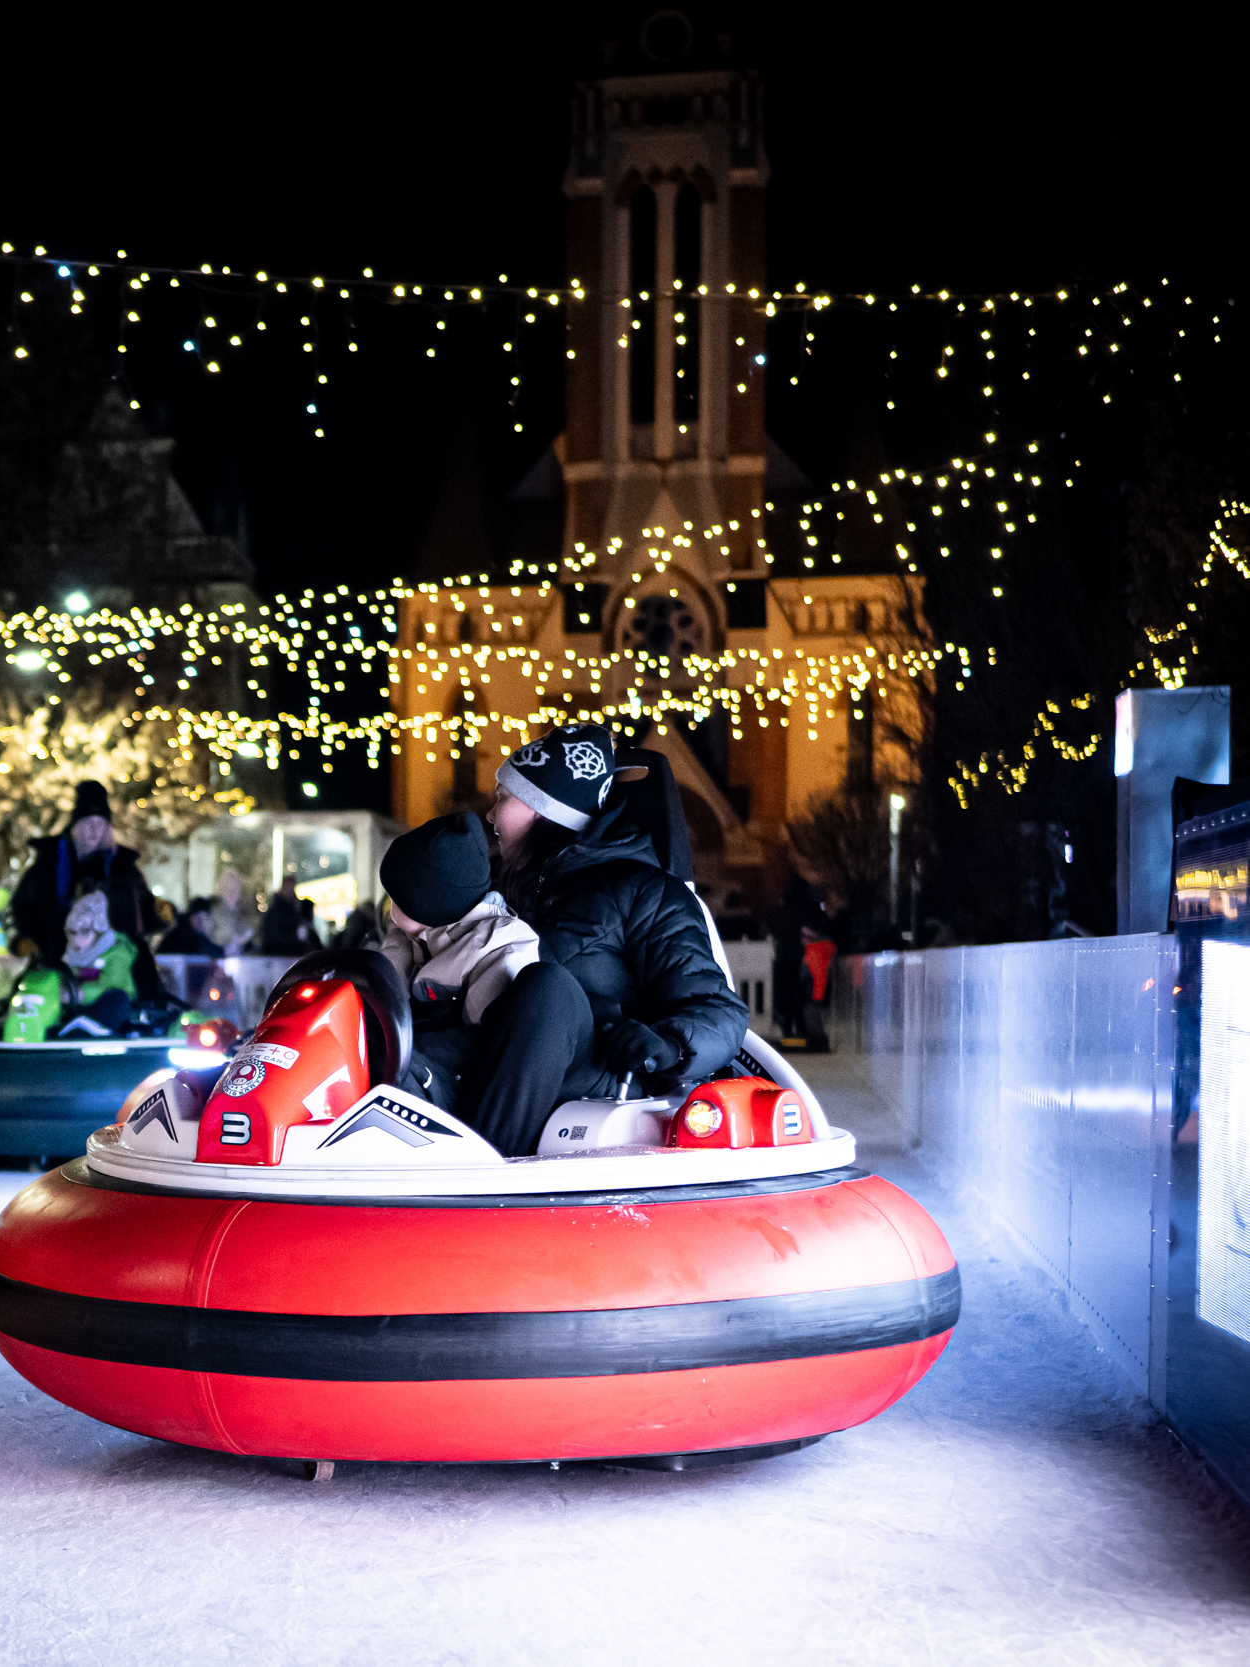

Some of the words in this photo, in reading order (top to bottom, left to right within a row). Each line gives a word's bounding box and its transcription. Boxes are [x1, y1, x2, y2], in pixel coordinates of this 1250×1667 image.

[263, 1055, 290, 1068] CARS
[220, 1111, 251, 1145] 3
[782, 1103, 802, 1136] 3
